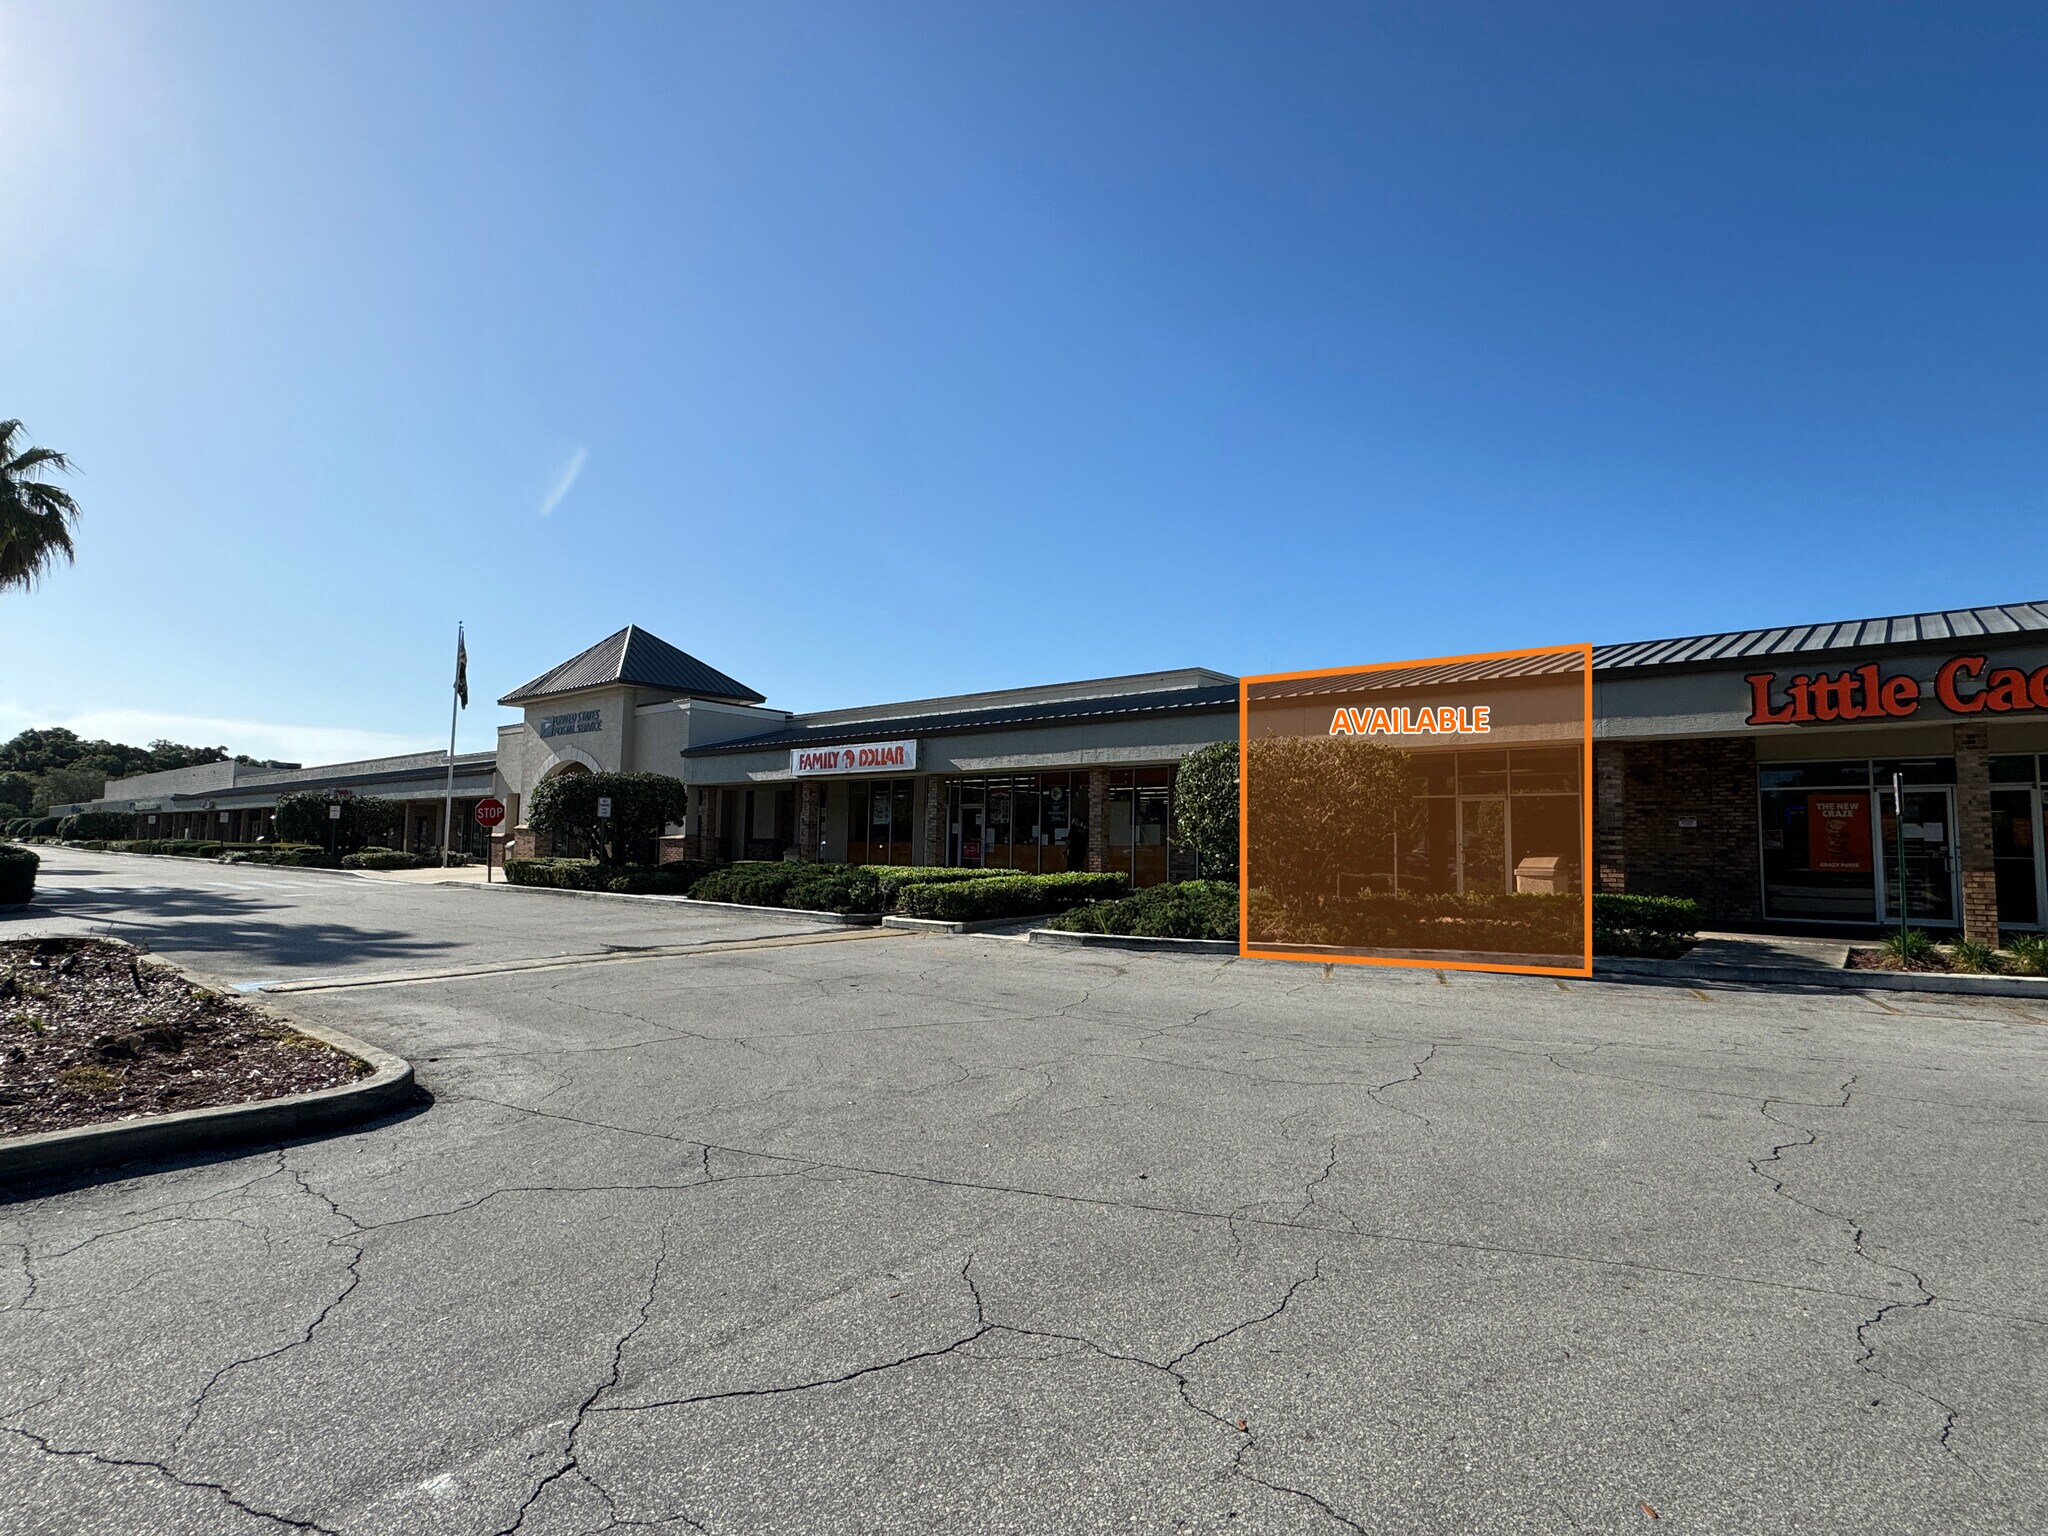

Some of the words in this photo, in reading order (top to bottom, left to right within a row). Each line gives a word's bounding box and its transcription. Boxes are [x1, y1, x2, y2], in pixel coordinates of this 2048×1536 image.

[1744, 662, 1921, 725] Little
[577, 709, 600, 723] STATES
[799, 752, 839, 770] FAMILY
[859, 746, 904, 766] DOLLAR
[477, 807, 503, 819] STOP
[1816, 802, 1835, 810] THE
[1836, 802, 1859, 810] NEW
